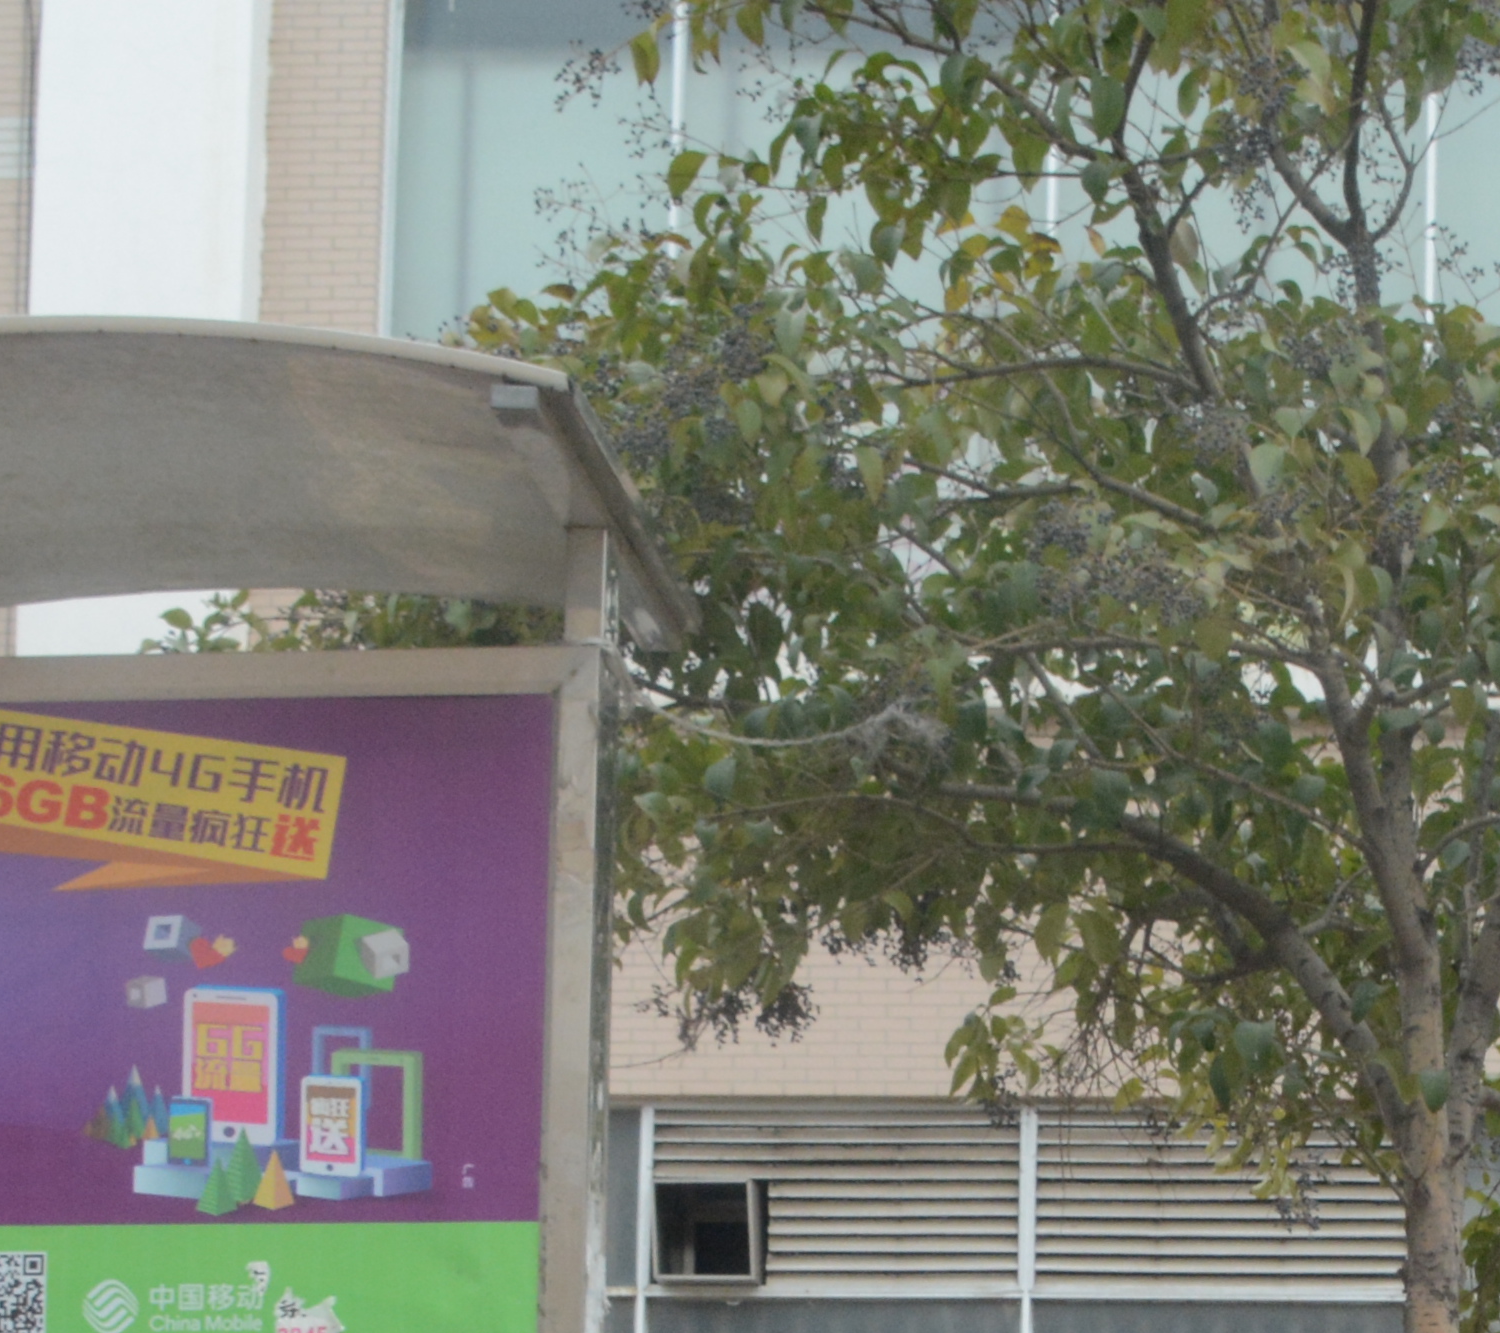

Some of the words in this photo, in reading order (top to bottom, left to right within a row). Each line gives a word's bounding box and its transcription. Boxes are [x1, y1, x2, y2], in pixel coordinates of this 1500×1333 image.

[148, 1282, 265, 1311] 中国移动
[148, 1315, 201, 1332] China
[205, 1315, 264, 1332] Mobile
